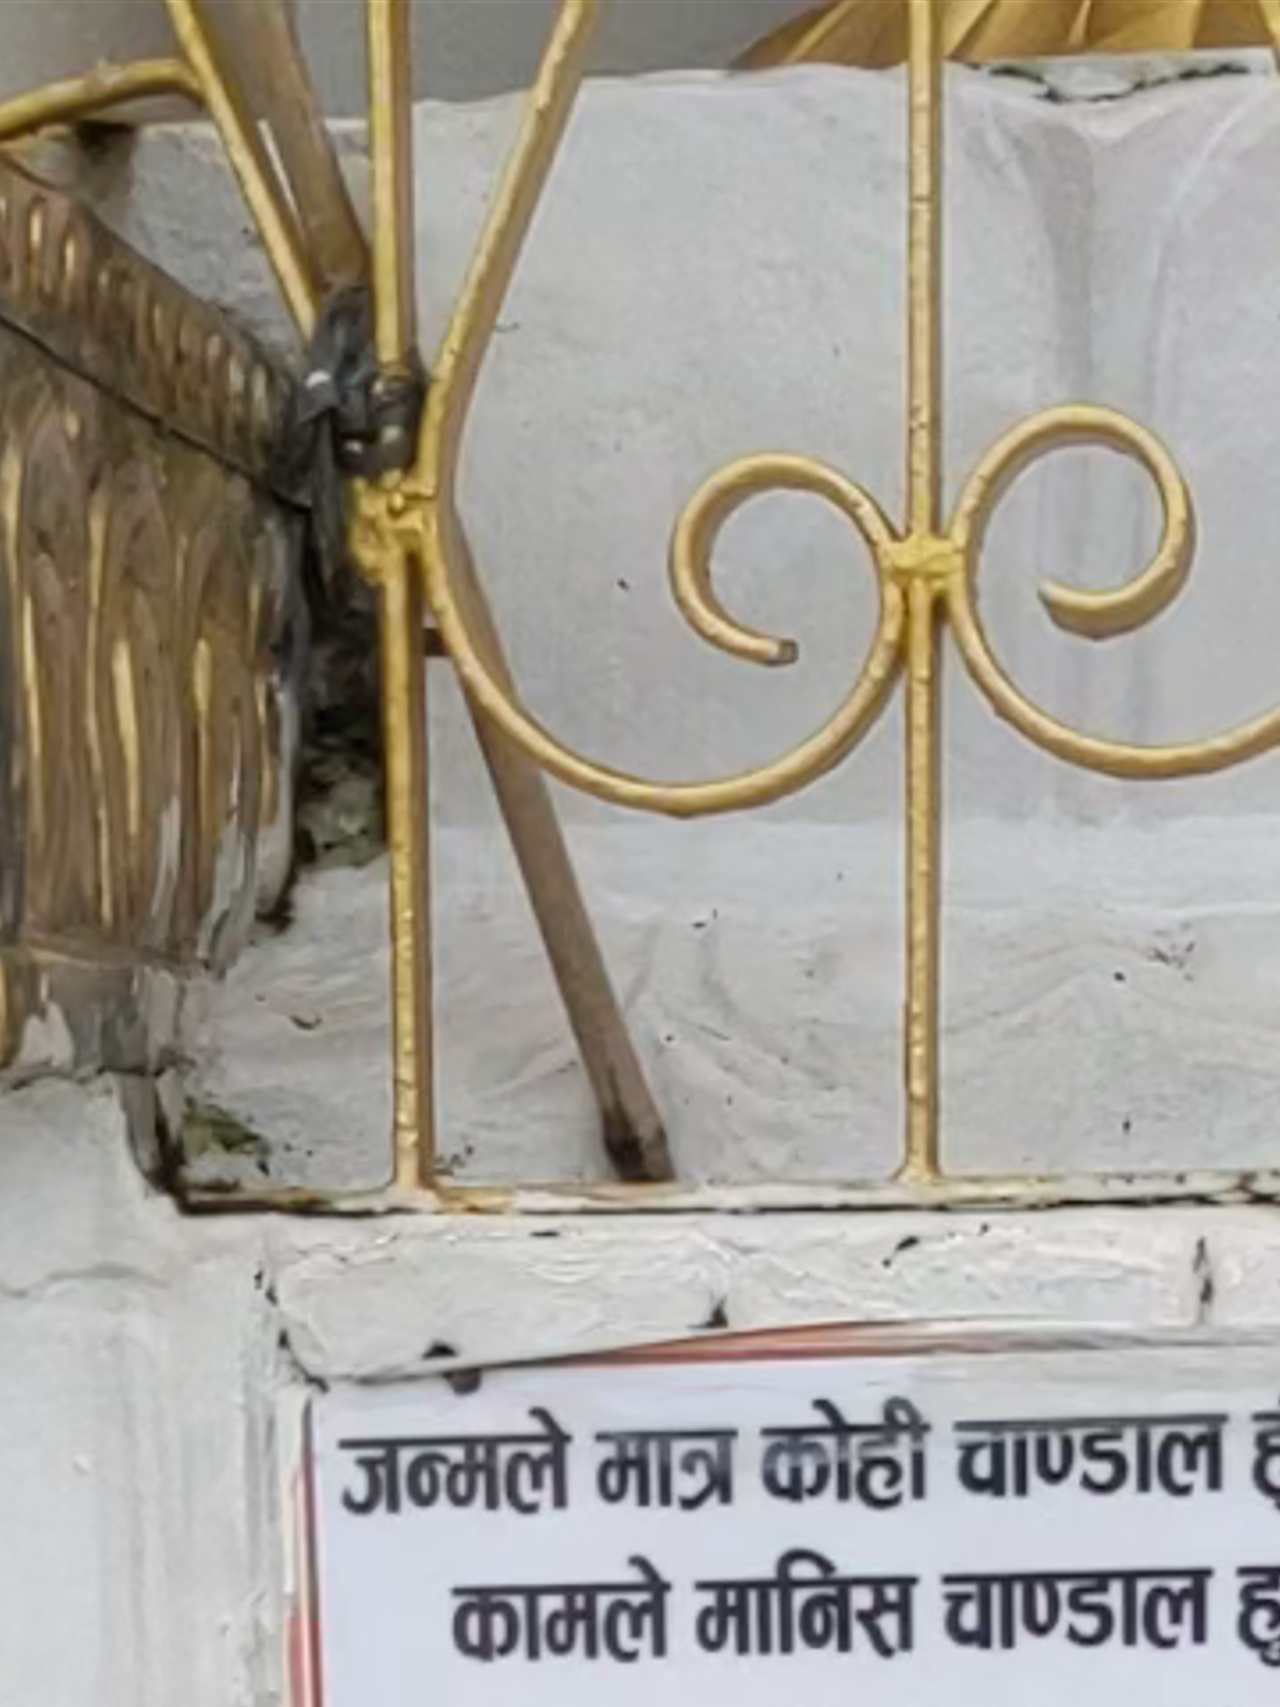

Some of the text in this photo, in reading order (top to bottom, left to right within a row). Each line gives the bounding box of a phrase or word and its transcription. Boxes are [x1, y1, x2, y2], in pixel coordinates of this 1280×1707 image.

[339, 1407, 572, 1514] जन्मले
[596, 1428, 738, 1511] मात्र
[761, 1396, 930, 1510] कोही
[953, 1413, 1228, 1497] चाण्डाल
[451, 1556, 671, 1660] कामले
[695, 1548, 919, 1658] मानिस
[941, 1567, 1214, 1650] चाण्डाल
